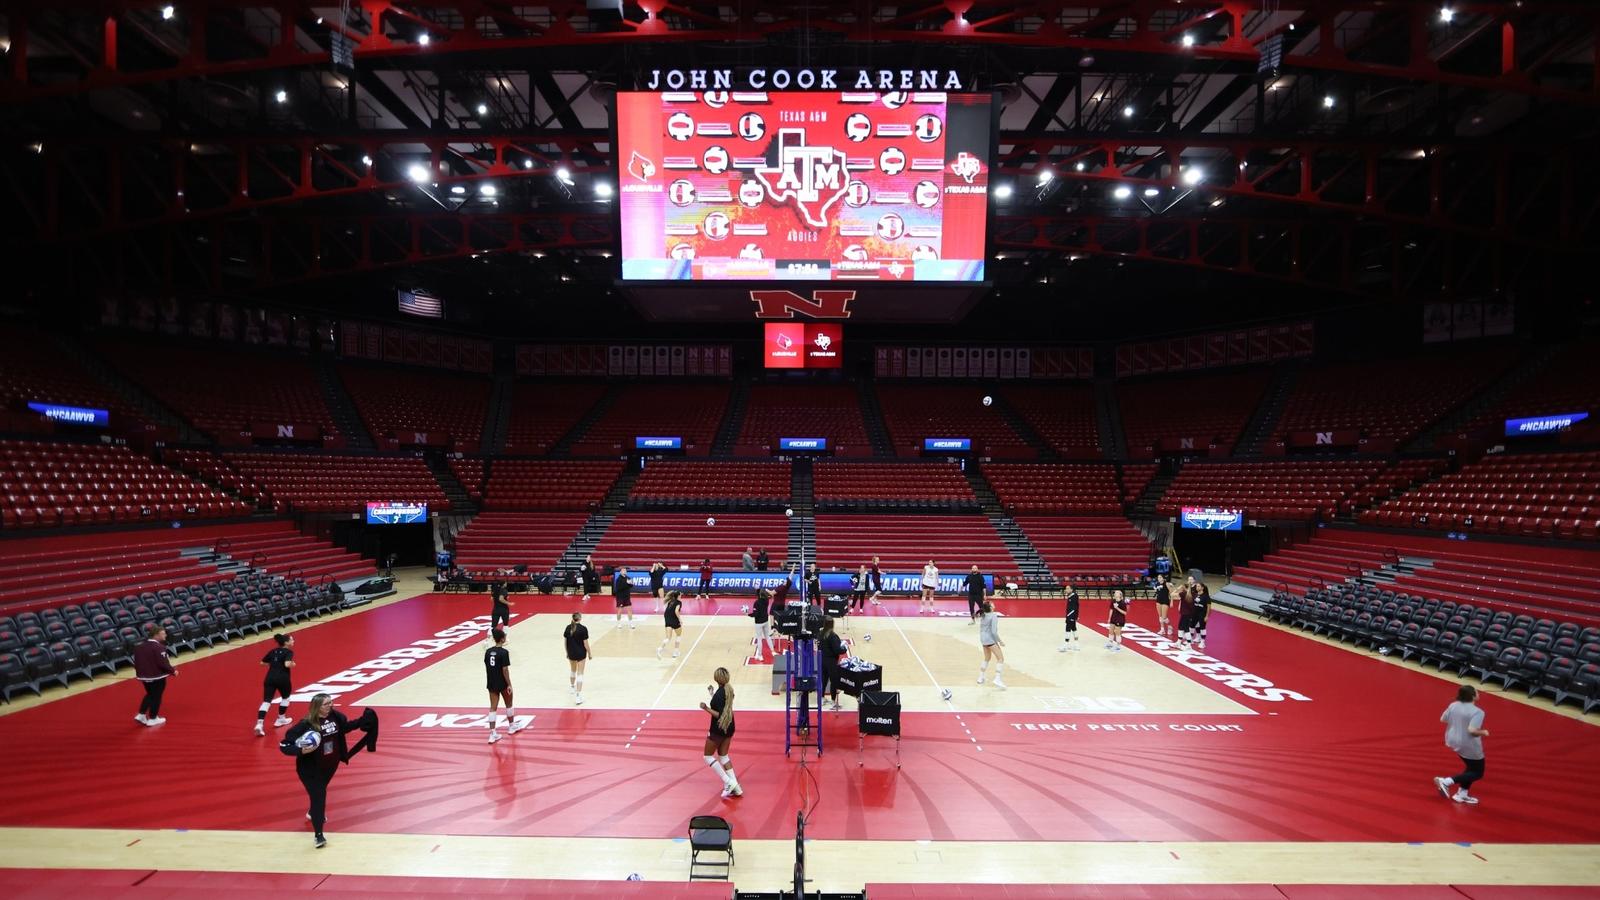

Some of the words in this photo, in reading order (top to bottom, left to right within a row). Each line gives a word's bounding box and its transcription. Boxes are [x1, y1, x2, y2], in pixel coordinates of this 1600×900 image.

[648, 70, 732, 89] JOHN
[750, 70, 838, 89] COOK
[854, 70, 962, 89] ARENA
[780, 111, 805, 122] TEXAS
[809, 111, 828, 122] A&M
[750, 290, 857, 318] N
[45, 409, 96, 423] #NCAAWVB
[1519, 418, 1572, 431] #NCAAWVB
[277, 424, 294, 438] N
[414, 432, 428, 444] N
[1180, 437, 1195, 449] N
[1315, 431, 1333, 445] N
[632, 576, 652, 587] NEW
[669, 577, 682, 587] OF
[681, 577, 717, 588] COLLE
[717, 577, 750, 588] SPORTS
[751, 577, 761, 588] IS
[270, 613, 519, 703] NEBRASK
[489, 655, 496, 667] 6
[863, 678, 879, 688] molten
[866, 716, 893, 725] molten
[1010, 723, 1078, 731] TERRY
[1087, 724, 1161, 732] PETTIT
[1168, 724, 1245, 733] COURT
